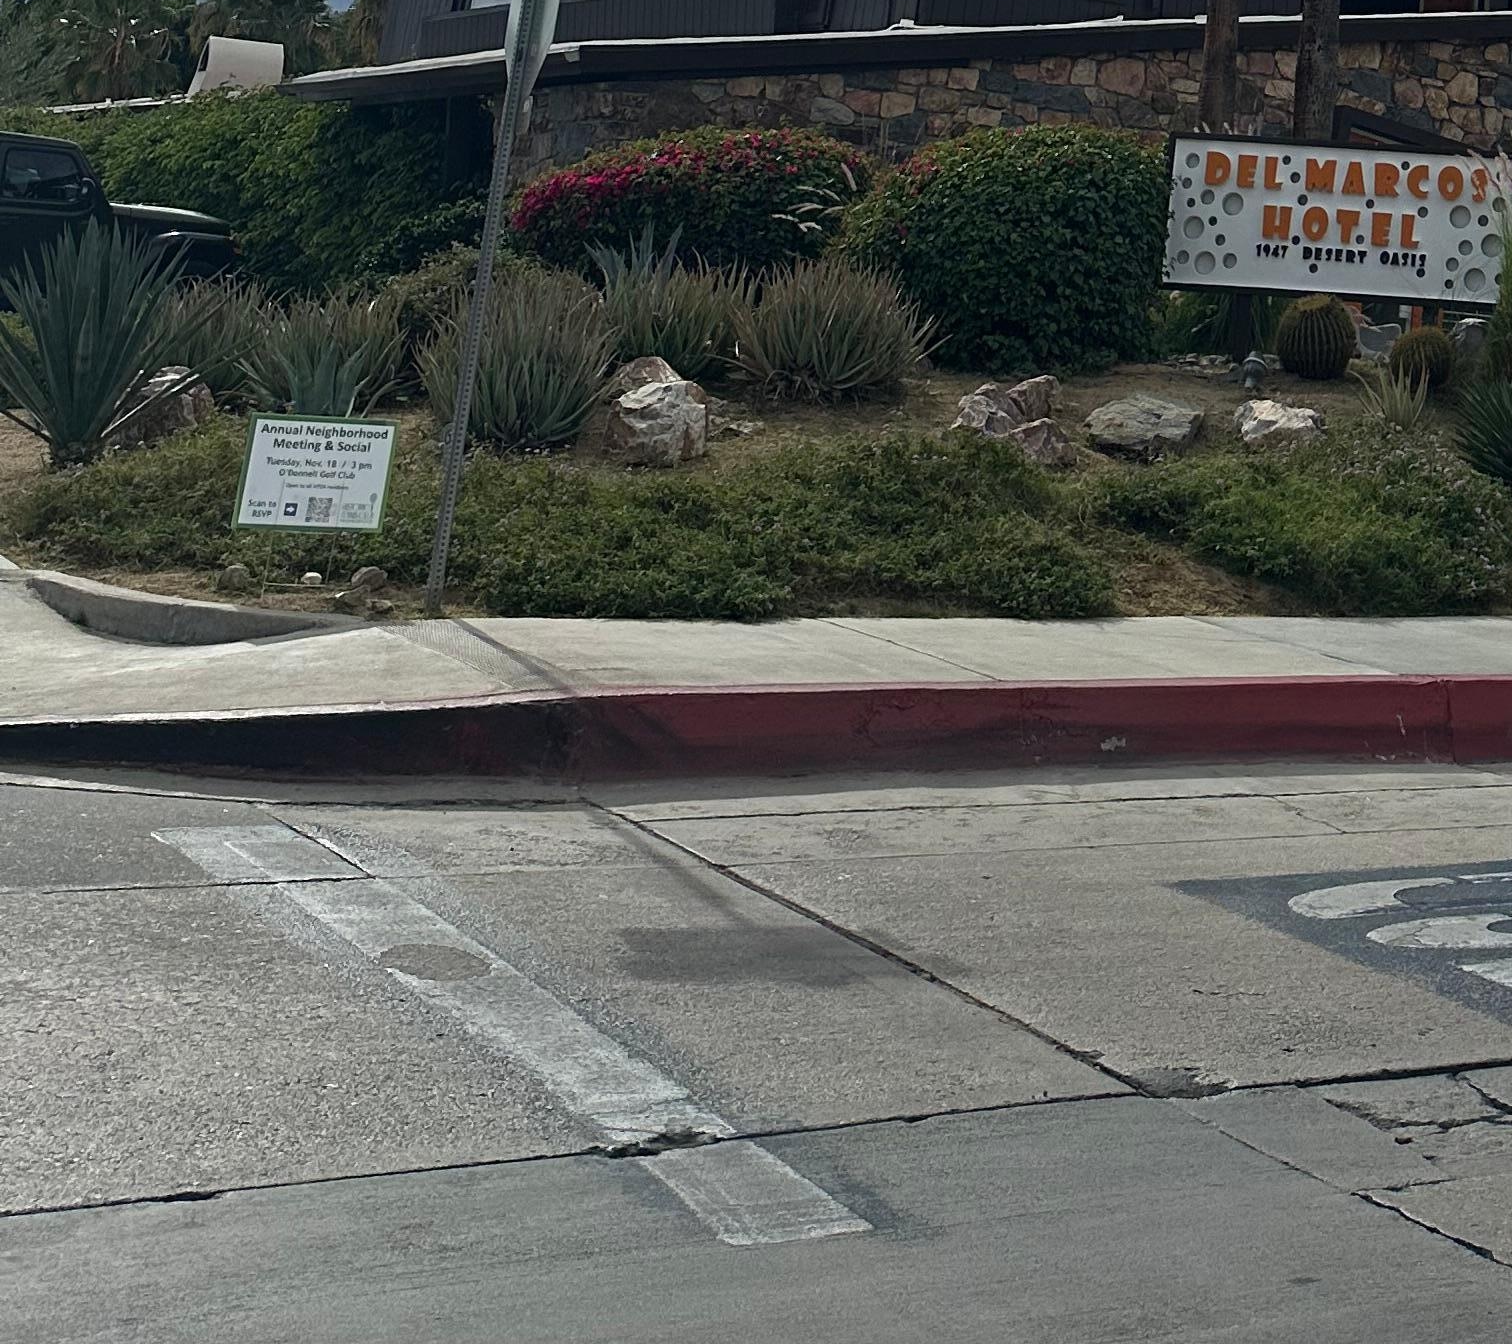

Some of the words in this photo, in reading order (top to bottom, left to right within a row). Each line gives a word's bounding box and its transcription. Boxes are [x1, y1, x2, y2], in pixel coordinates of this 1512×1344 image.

[1204, 151, 1284, 190] DEL
[1304, 158, 1489, 203] MARCOS
[1262, 204, 1420, 250] HOTEL
[1256, 243, 1289, 259] 1947
[1302, 246, 1368, 264] DESERT
[1379, 250, 1427, 268] OASIS
[261, 423, 303, 435] Annual
[305, 425, 389, 440] Neighborhood
[272, 438, 322, 453] Meeting
[324, 440, 334, 451] &
[337, 441, 372, 453] Social
[248, 499, 267, 508] Scan
[252, 509, 273, 519] RSVP
